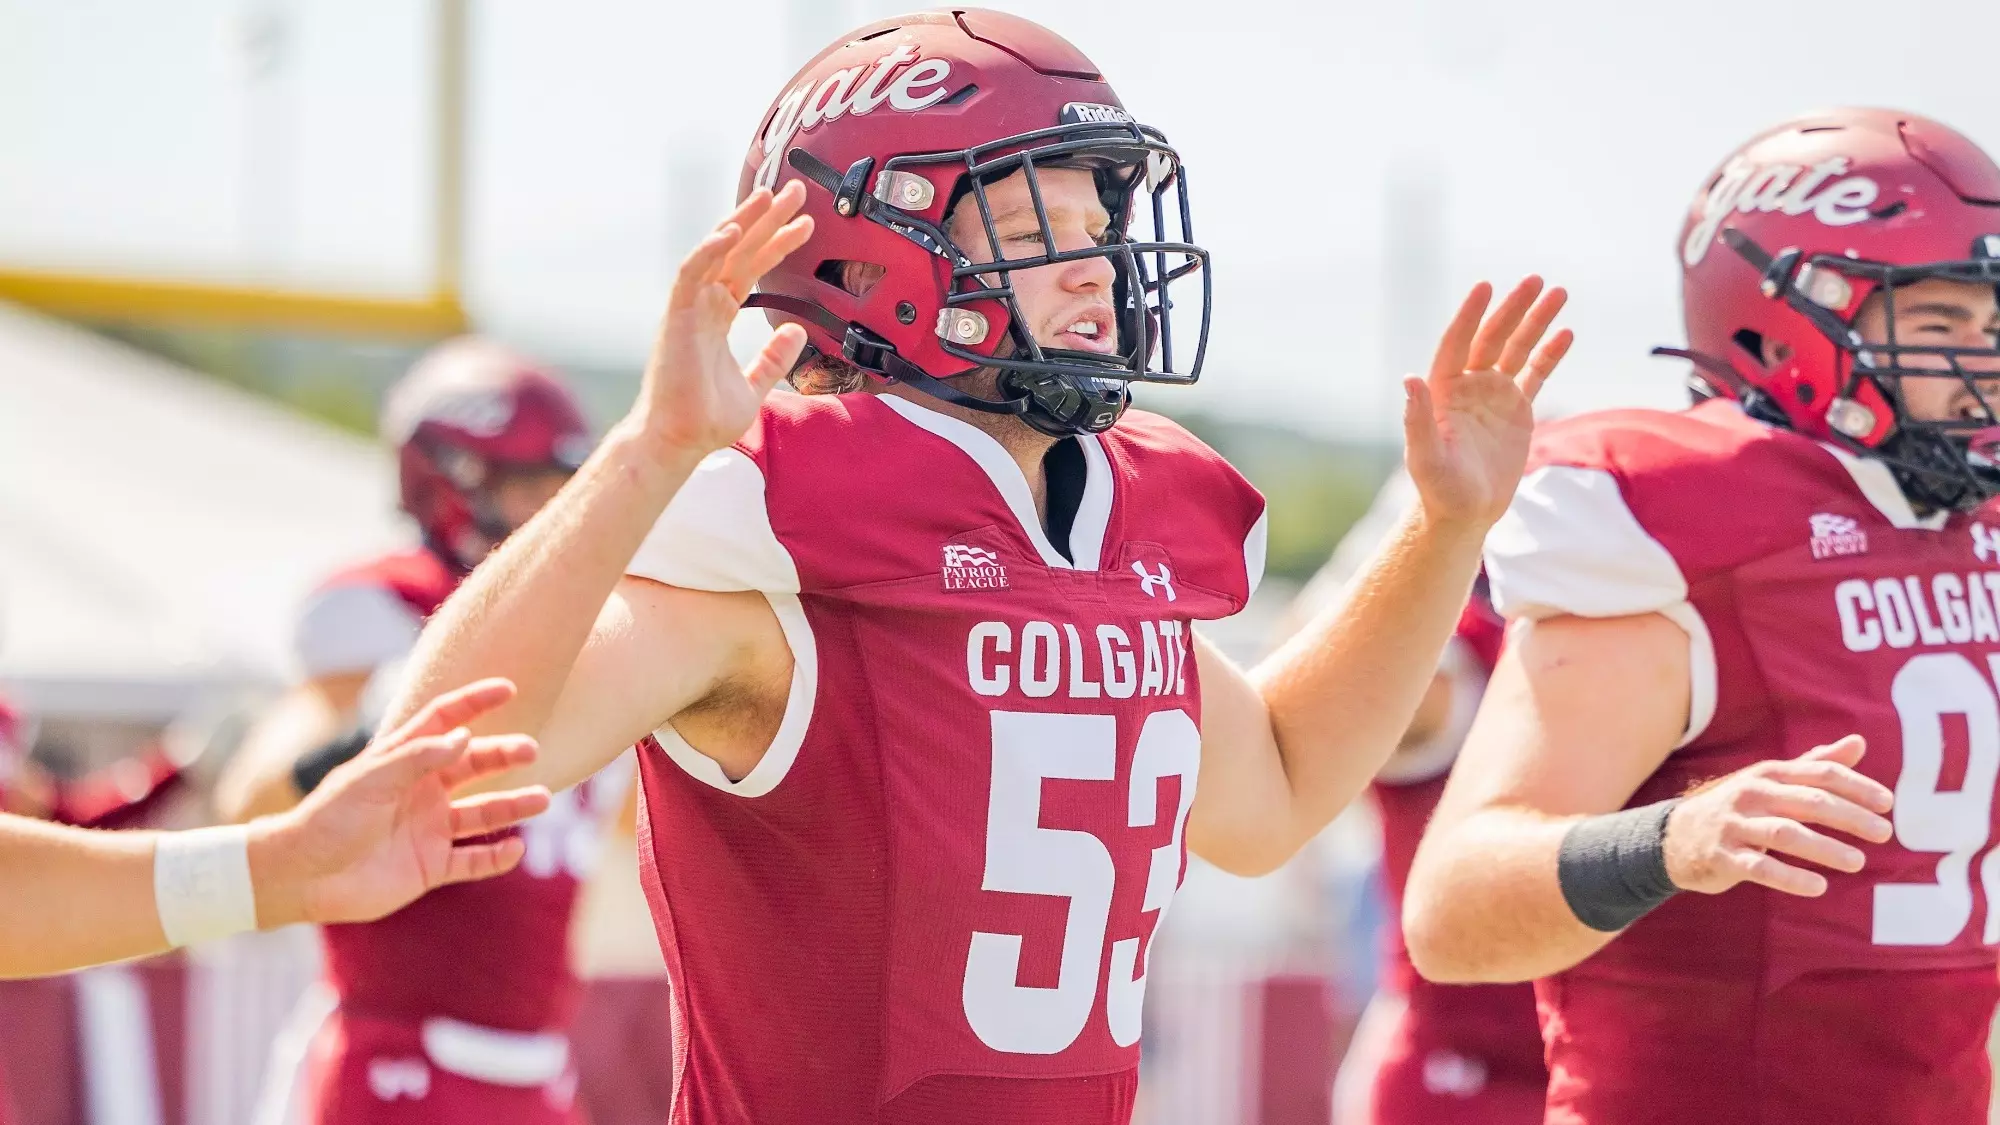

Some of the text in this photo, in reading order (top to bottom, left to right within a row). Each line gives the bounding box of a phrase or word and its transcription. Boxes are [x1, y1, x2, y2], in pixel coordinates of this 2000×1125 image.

[1684, 156, 1880, 266] gate
[942, 566, 1006, 579] PATRIOT
[944, 577, 1009, 590] LEAGUE
[966, 620, 1186, 699] COLGATE
[1871, 652, 2000, 946] 9
[962, 708, 1202, 1055] 53
